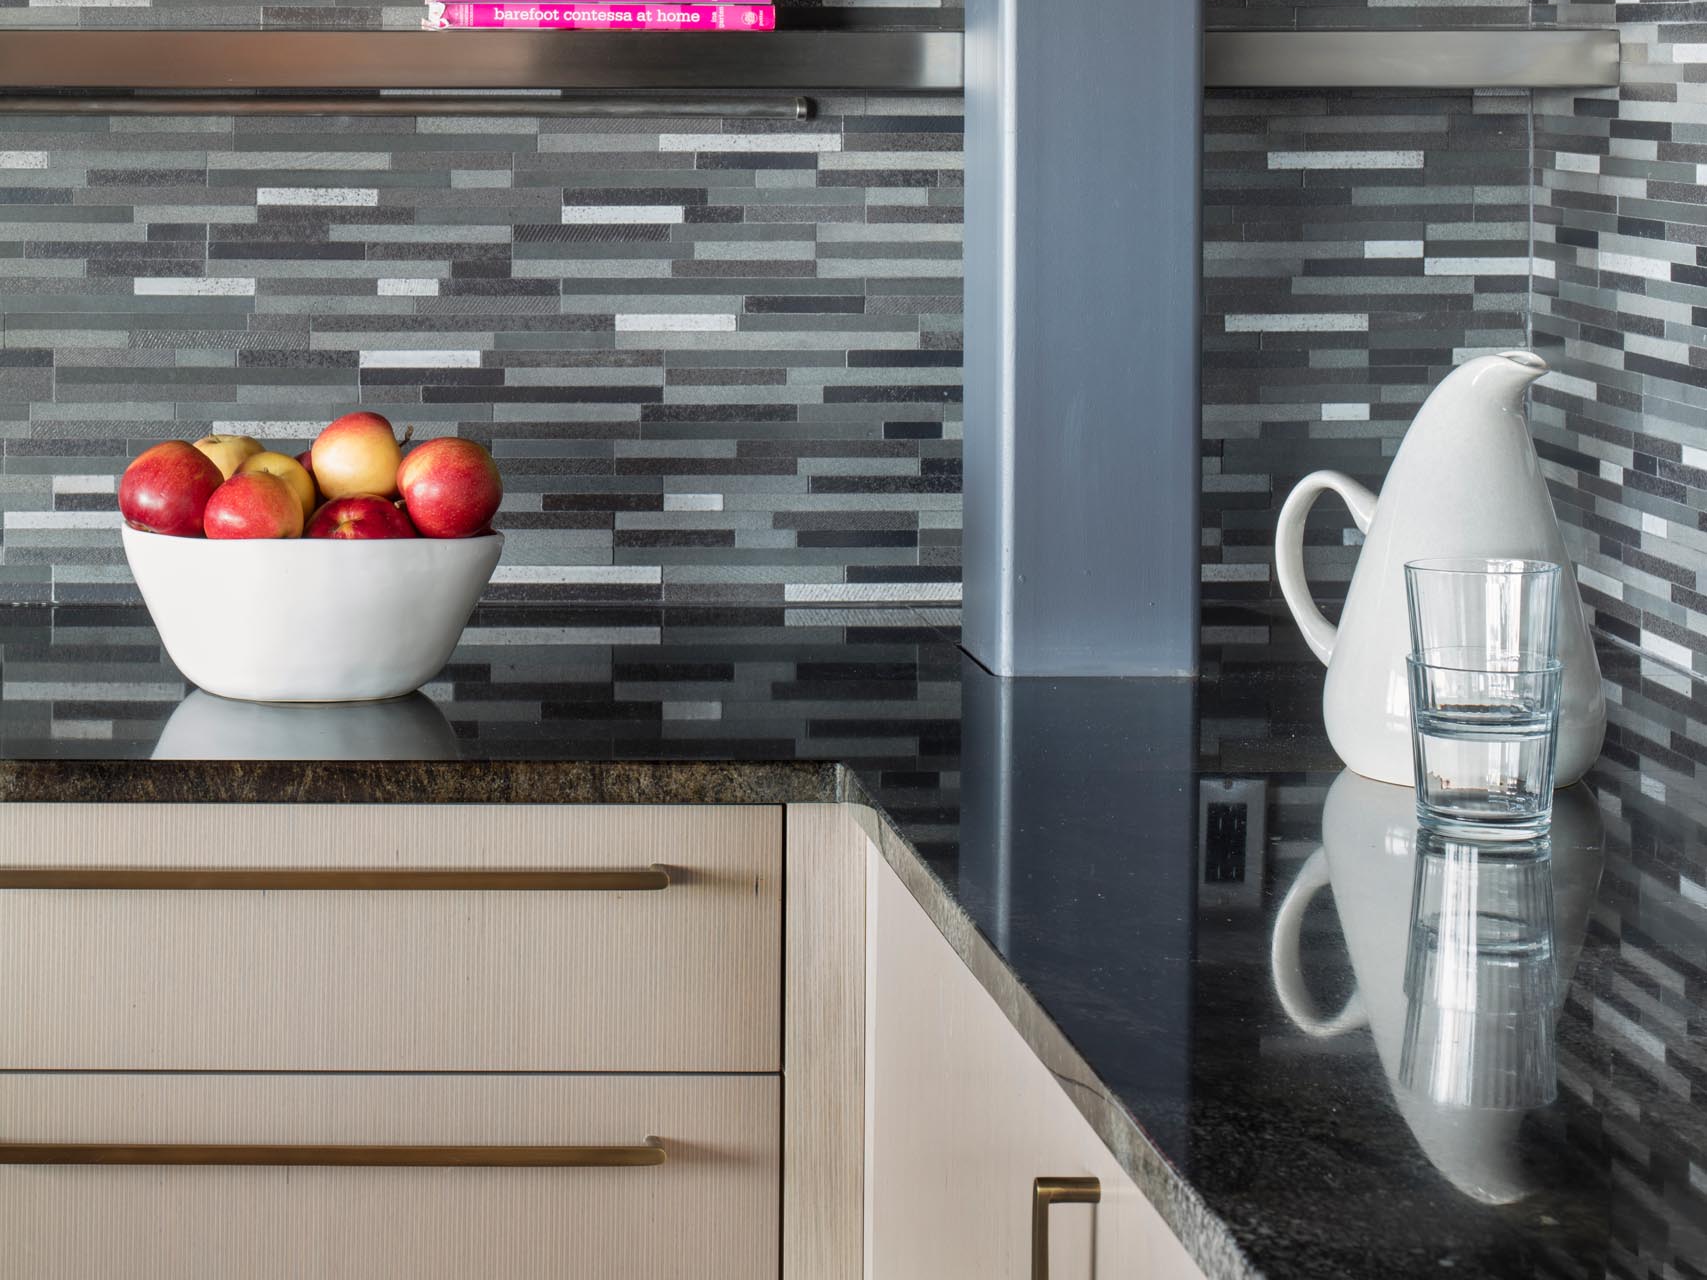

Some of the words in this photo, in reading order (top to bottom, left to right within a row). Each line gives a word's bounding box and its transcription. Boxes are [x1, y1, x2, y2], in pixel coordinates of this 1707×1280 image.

[494, 8, 559, 21] barefoot
[563, 10, 632, 22] contessa
[636, 10, 653, 22] at
[656, 9, 700, 22] home
